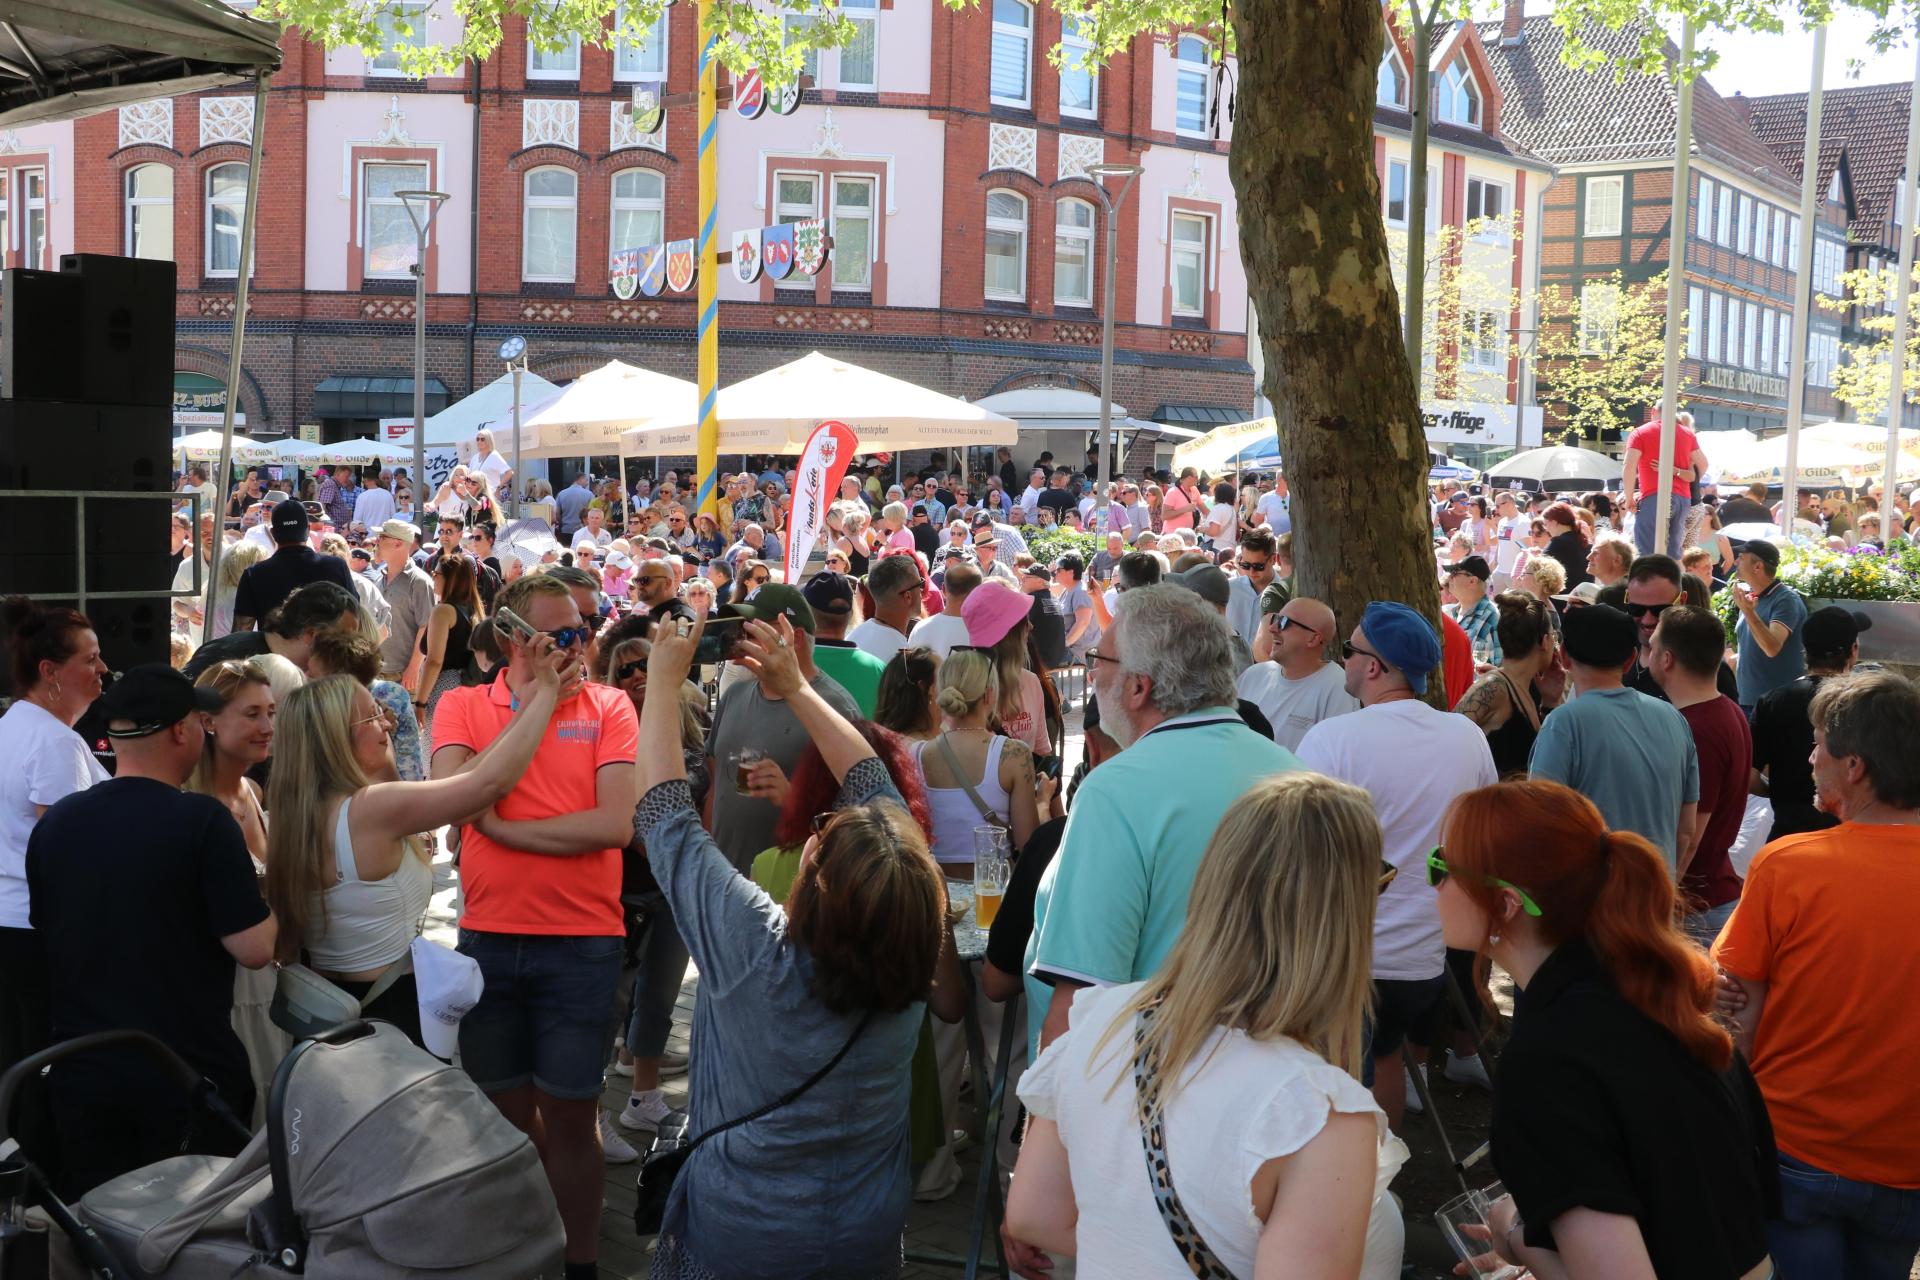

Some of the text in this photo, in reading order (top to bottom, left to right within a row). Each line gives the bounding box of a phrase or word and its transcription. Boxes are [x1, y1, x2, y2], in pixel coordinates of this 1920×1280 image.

[1710, 366, 1786, 397] ALTE APOTHEKE
[1241, 422, 1265, 432] Gilde
[1805, 467, 1838, 477] Gilde
[291, 1107, 303, 1156] nuna
